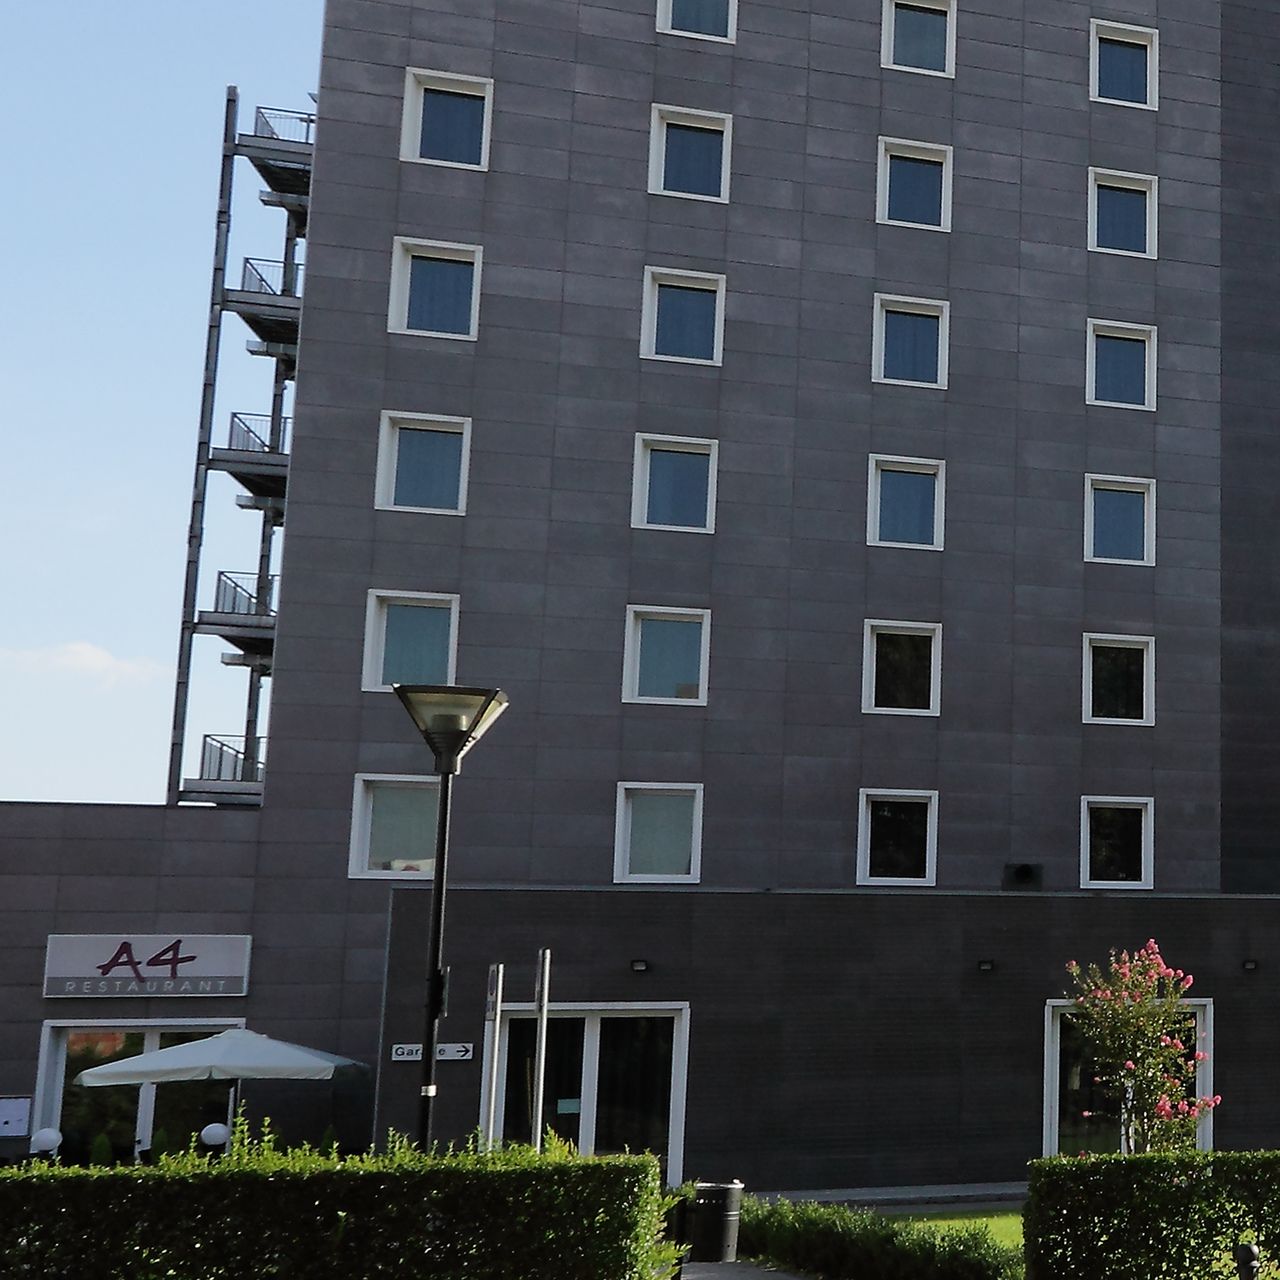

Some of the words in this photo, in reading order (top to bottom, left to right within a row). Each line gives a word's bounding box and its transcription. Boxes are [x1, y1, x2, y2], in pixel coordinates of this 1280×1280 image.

[97, 938, 197, 983] A4
[64, 980, 227, 993] RESTAURANT
[395, 1046, 446, 1058] Gare
